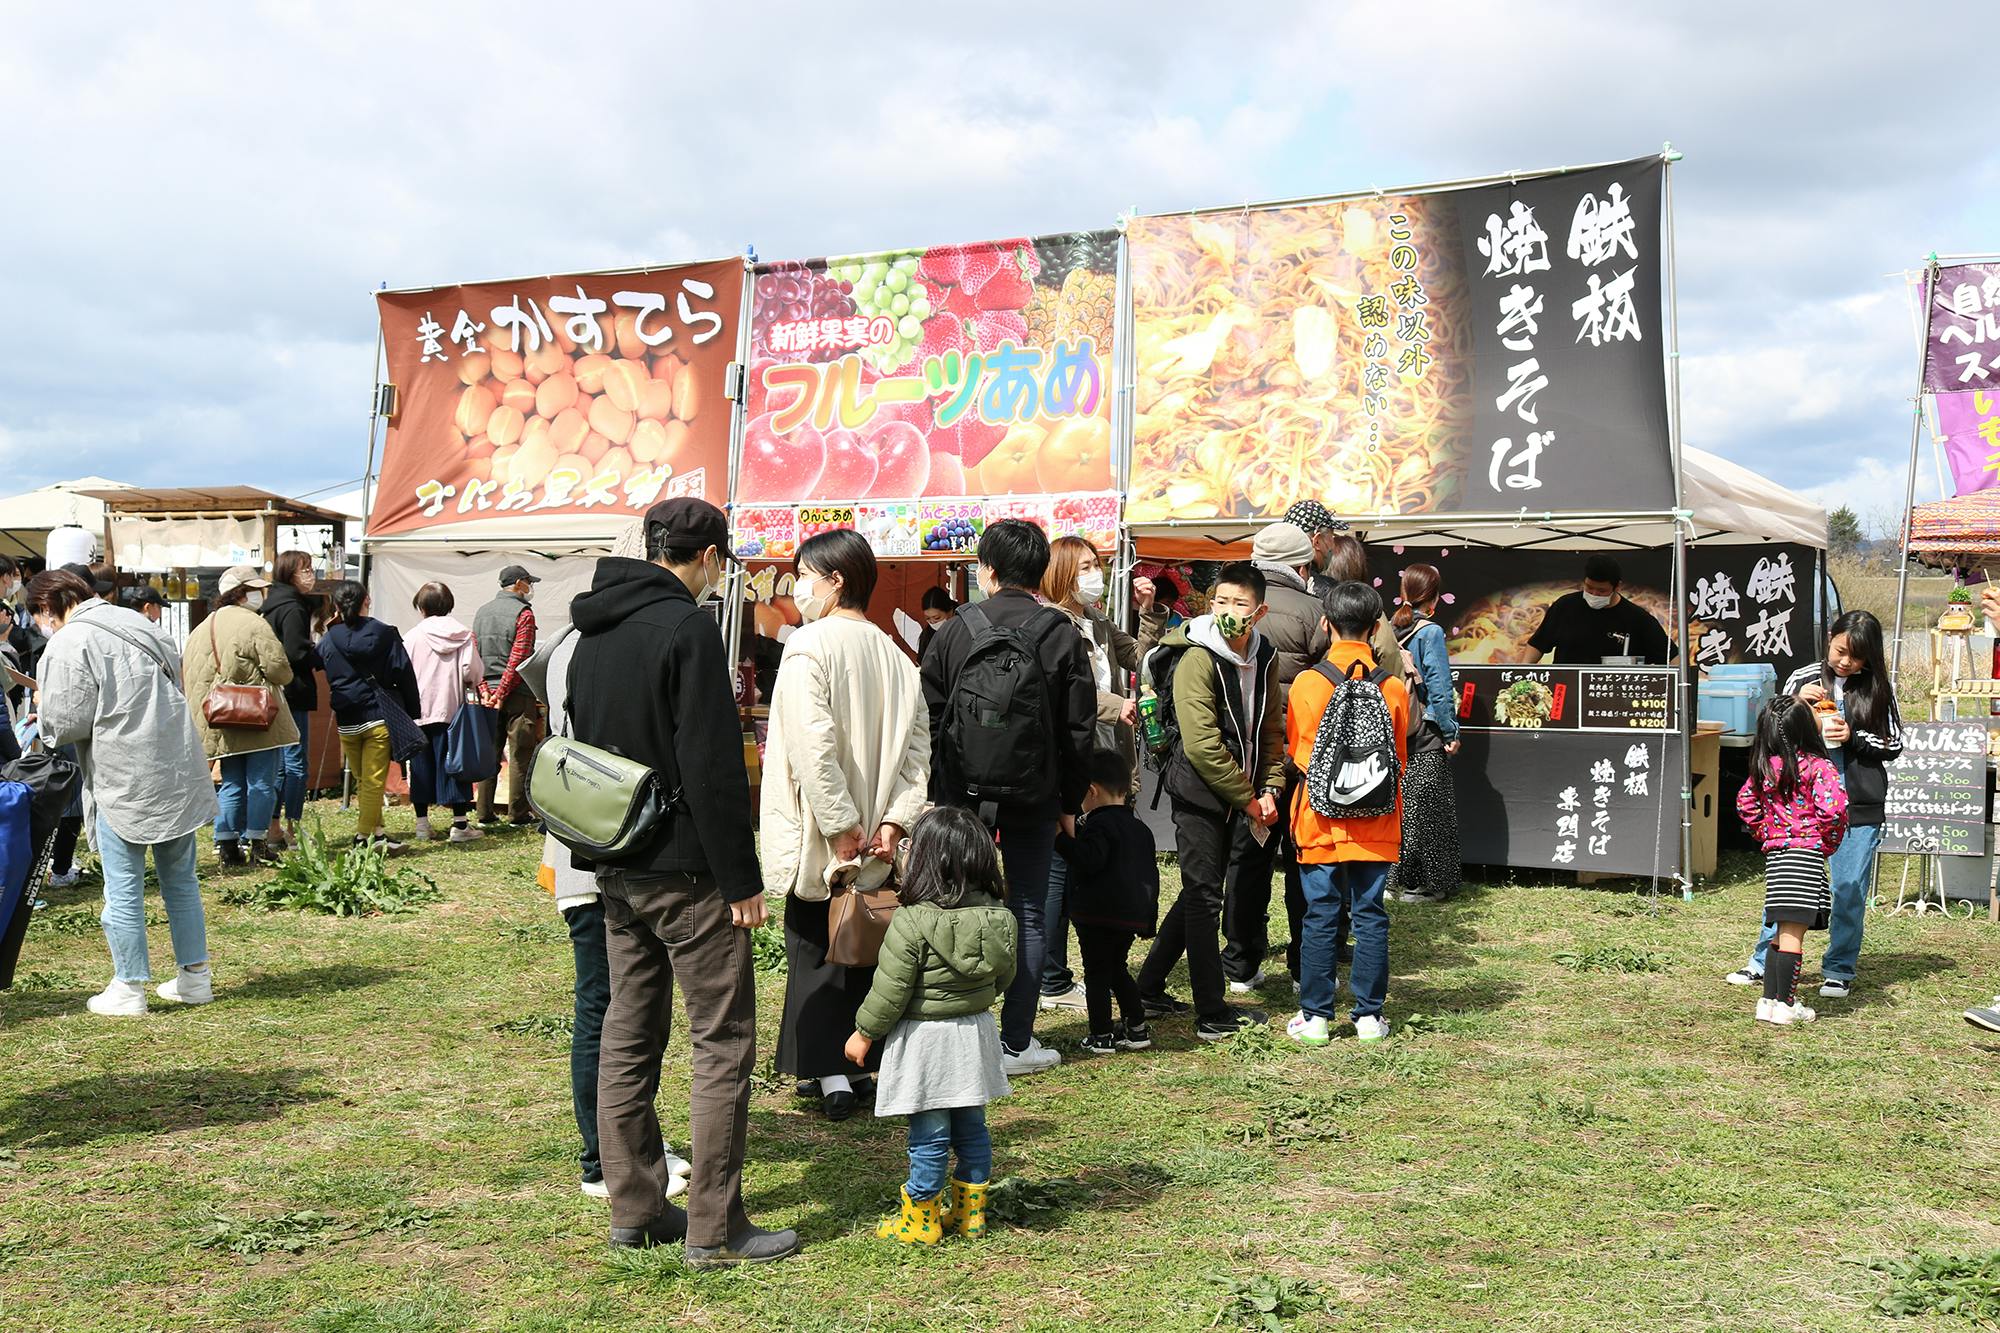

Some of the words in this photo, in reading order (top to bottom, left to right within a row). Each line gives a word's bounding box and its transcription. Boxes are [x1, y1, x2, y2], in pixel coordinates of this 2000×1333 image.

[1566, 181, 1642, 347] 鉄板
[1388, 213, 1433, 377] この味以外
[769, 315, 895, 353] 新鮮果実の
[1476, 200, 1556, 493] 焼きそば
[763, 336, 1103, 435] フルーツあめ
[1955, 351, 2000, 383] ス
[737, 527, 794, 540] フルーツあめ
[800, 508, 853, 523] りんごあめ
[1055, 517, 1116, 532] フルーツあめ
[1690, 571, 1740, 672] 焼き
[1746, 552, 1796, 657] 鉄板
[1501, 670, 1550, 683] ぼっかけ
[1590, 673, 1668, 682] トッピングメニュー
[1510, 718, 1542, 728] ¥700
[1639, 718, 1667, 728] ¥200
[1641, 699, 1667, 709] ¥100
[1335, 751, 1385, 789] NIKE
[1624, 742, 1650, 796] 鉄板
[1551, 786, 1581, 863] 専門店
[1588, 758, 1616, 855] 焼きそば
[27, 877, 42, 906] STAG
